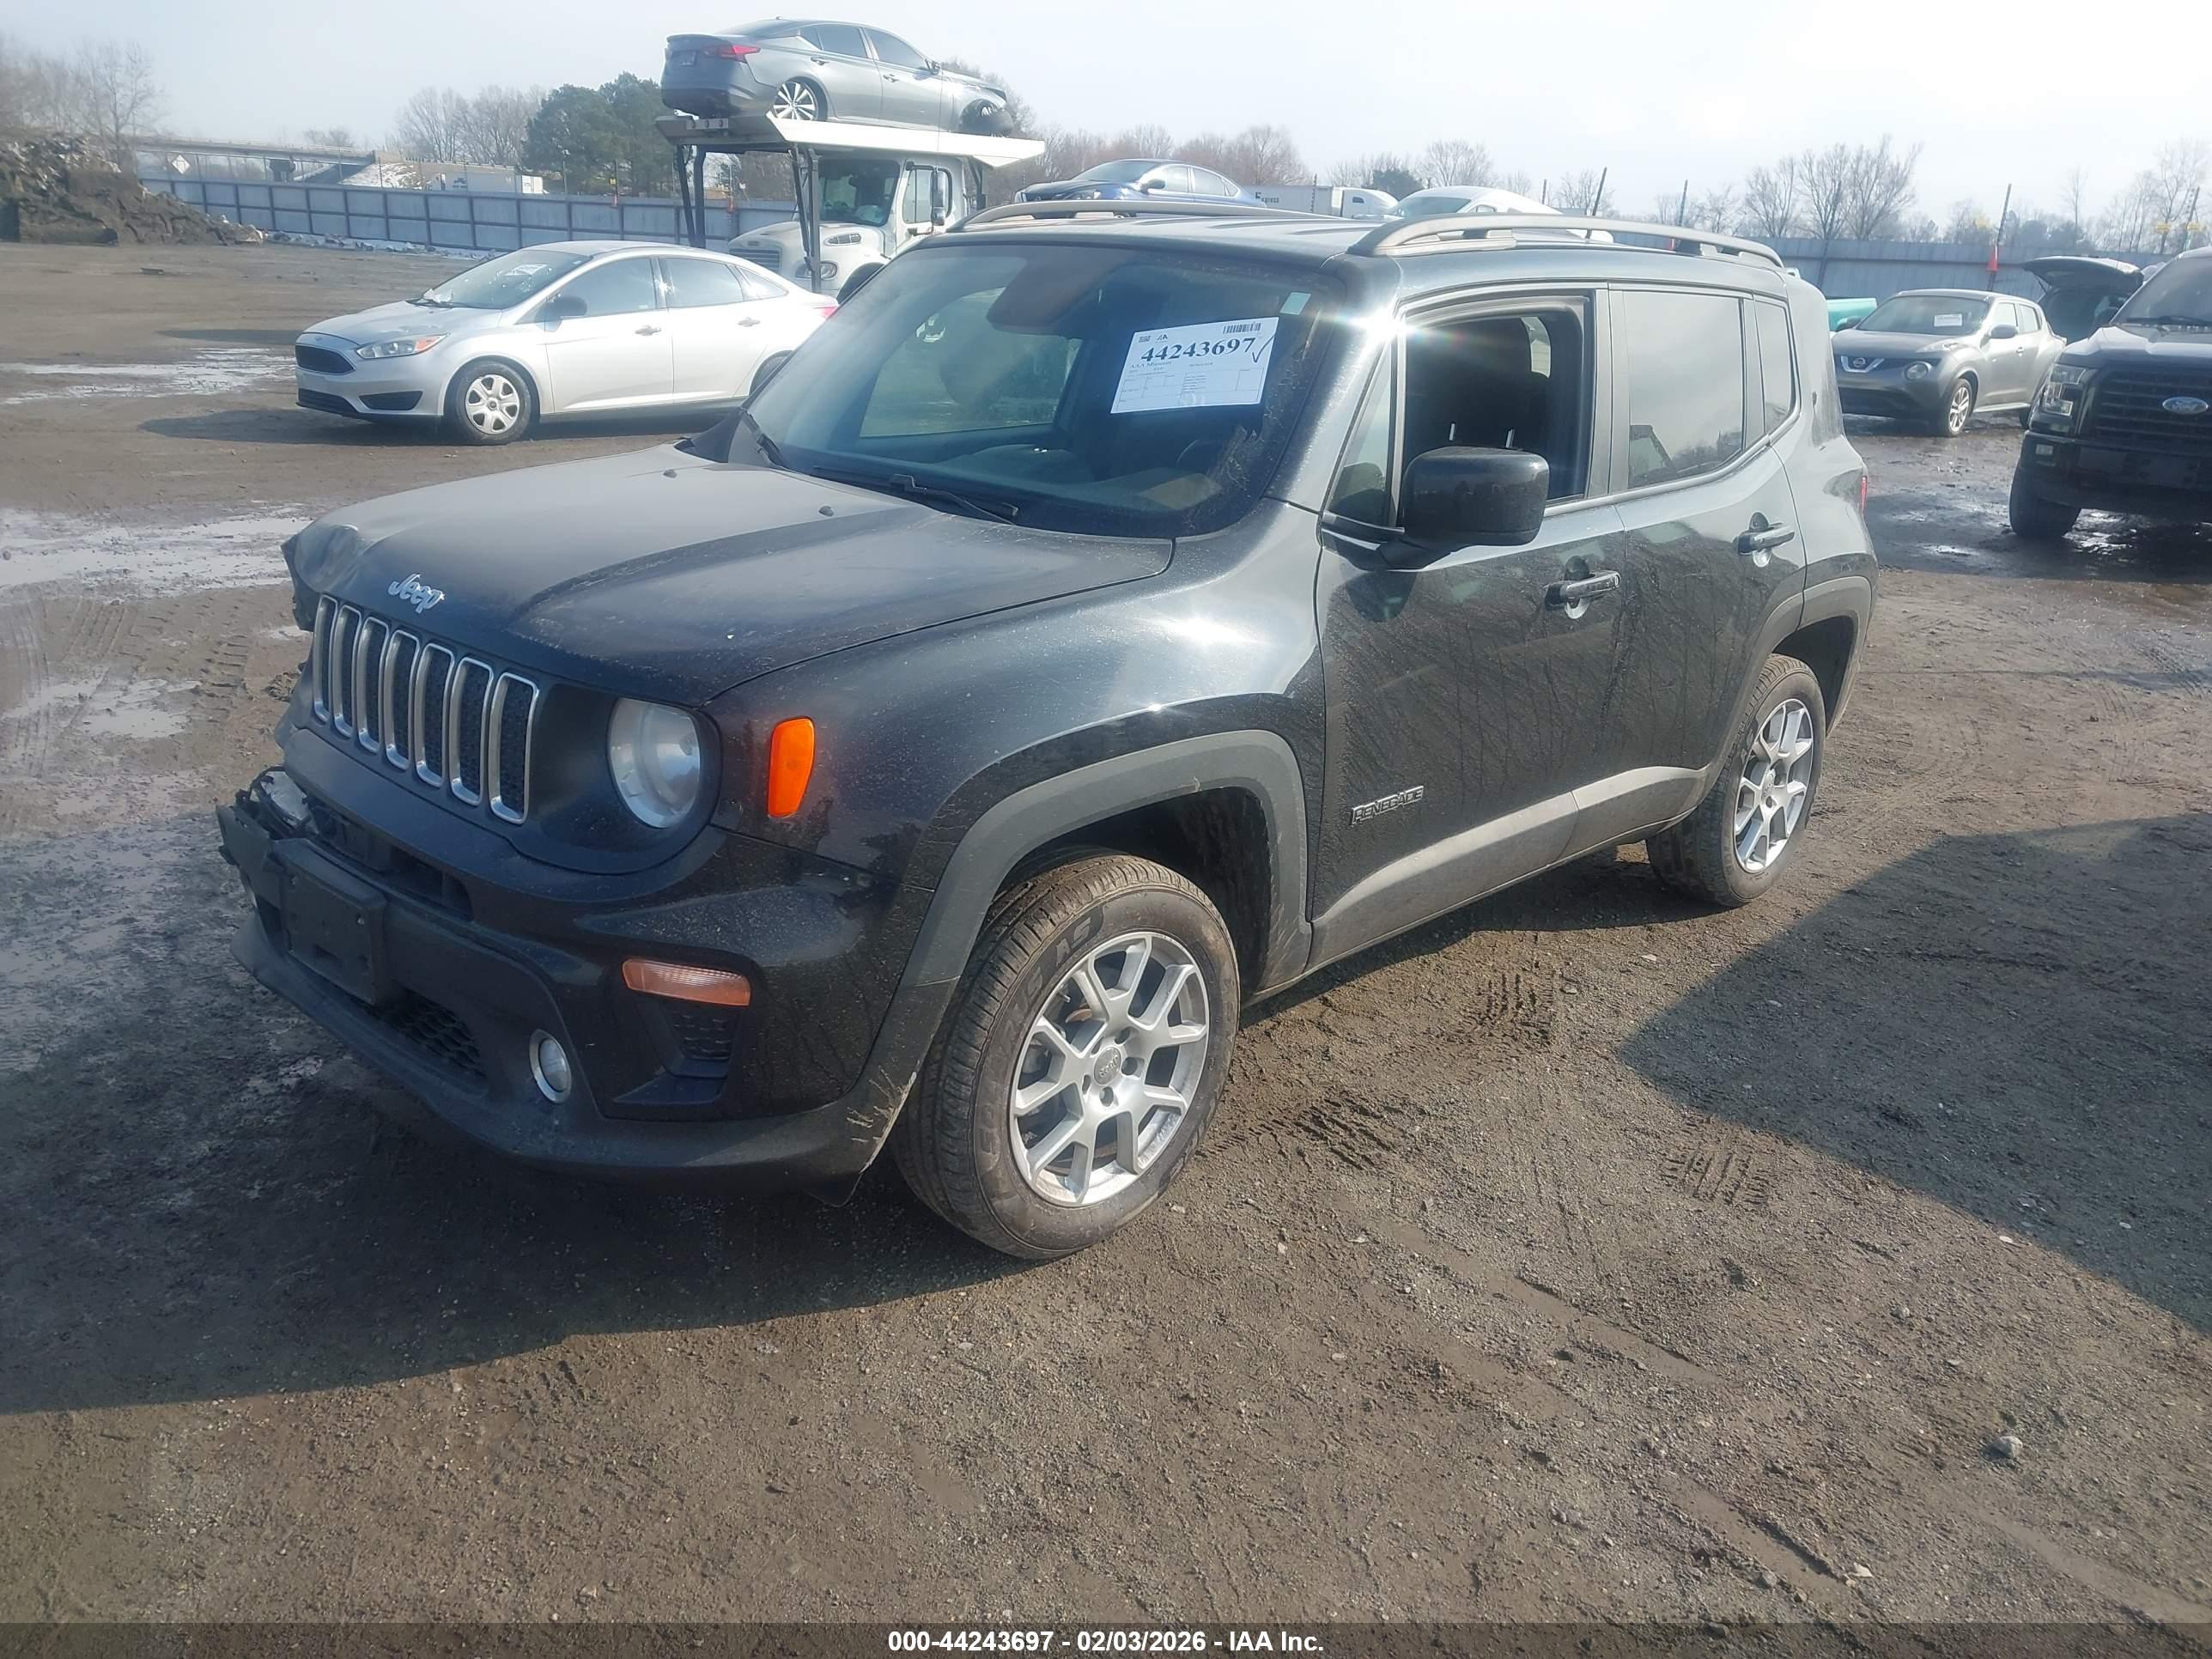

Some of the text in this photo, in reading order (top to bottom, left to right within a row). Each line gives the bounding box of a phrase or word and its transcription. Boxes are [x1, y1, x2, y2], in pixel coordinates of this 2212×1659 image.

[1255, 191, 1279, 204] Express
[1140, 337, 1256, 362] 44243697
[387, 573, 446, 614] Jeep
[1351, 785, 1425, 827] RENEGADE
